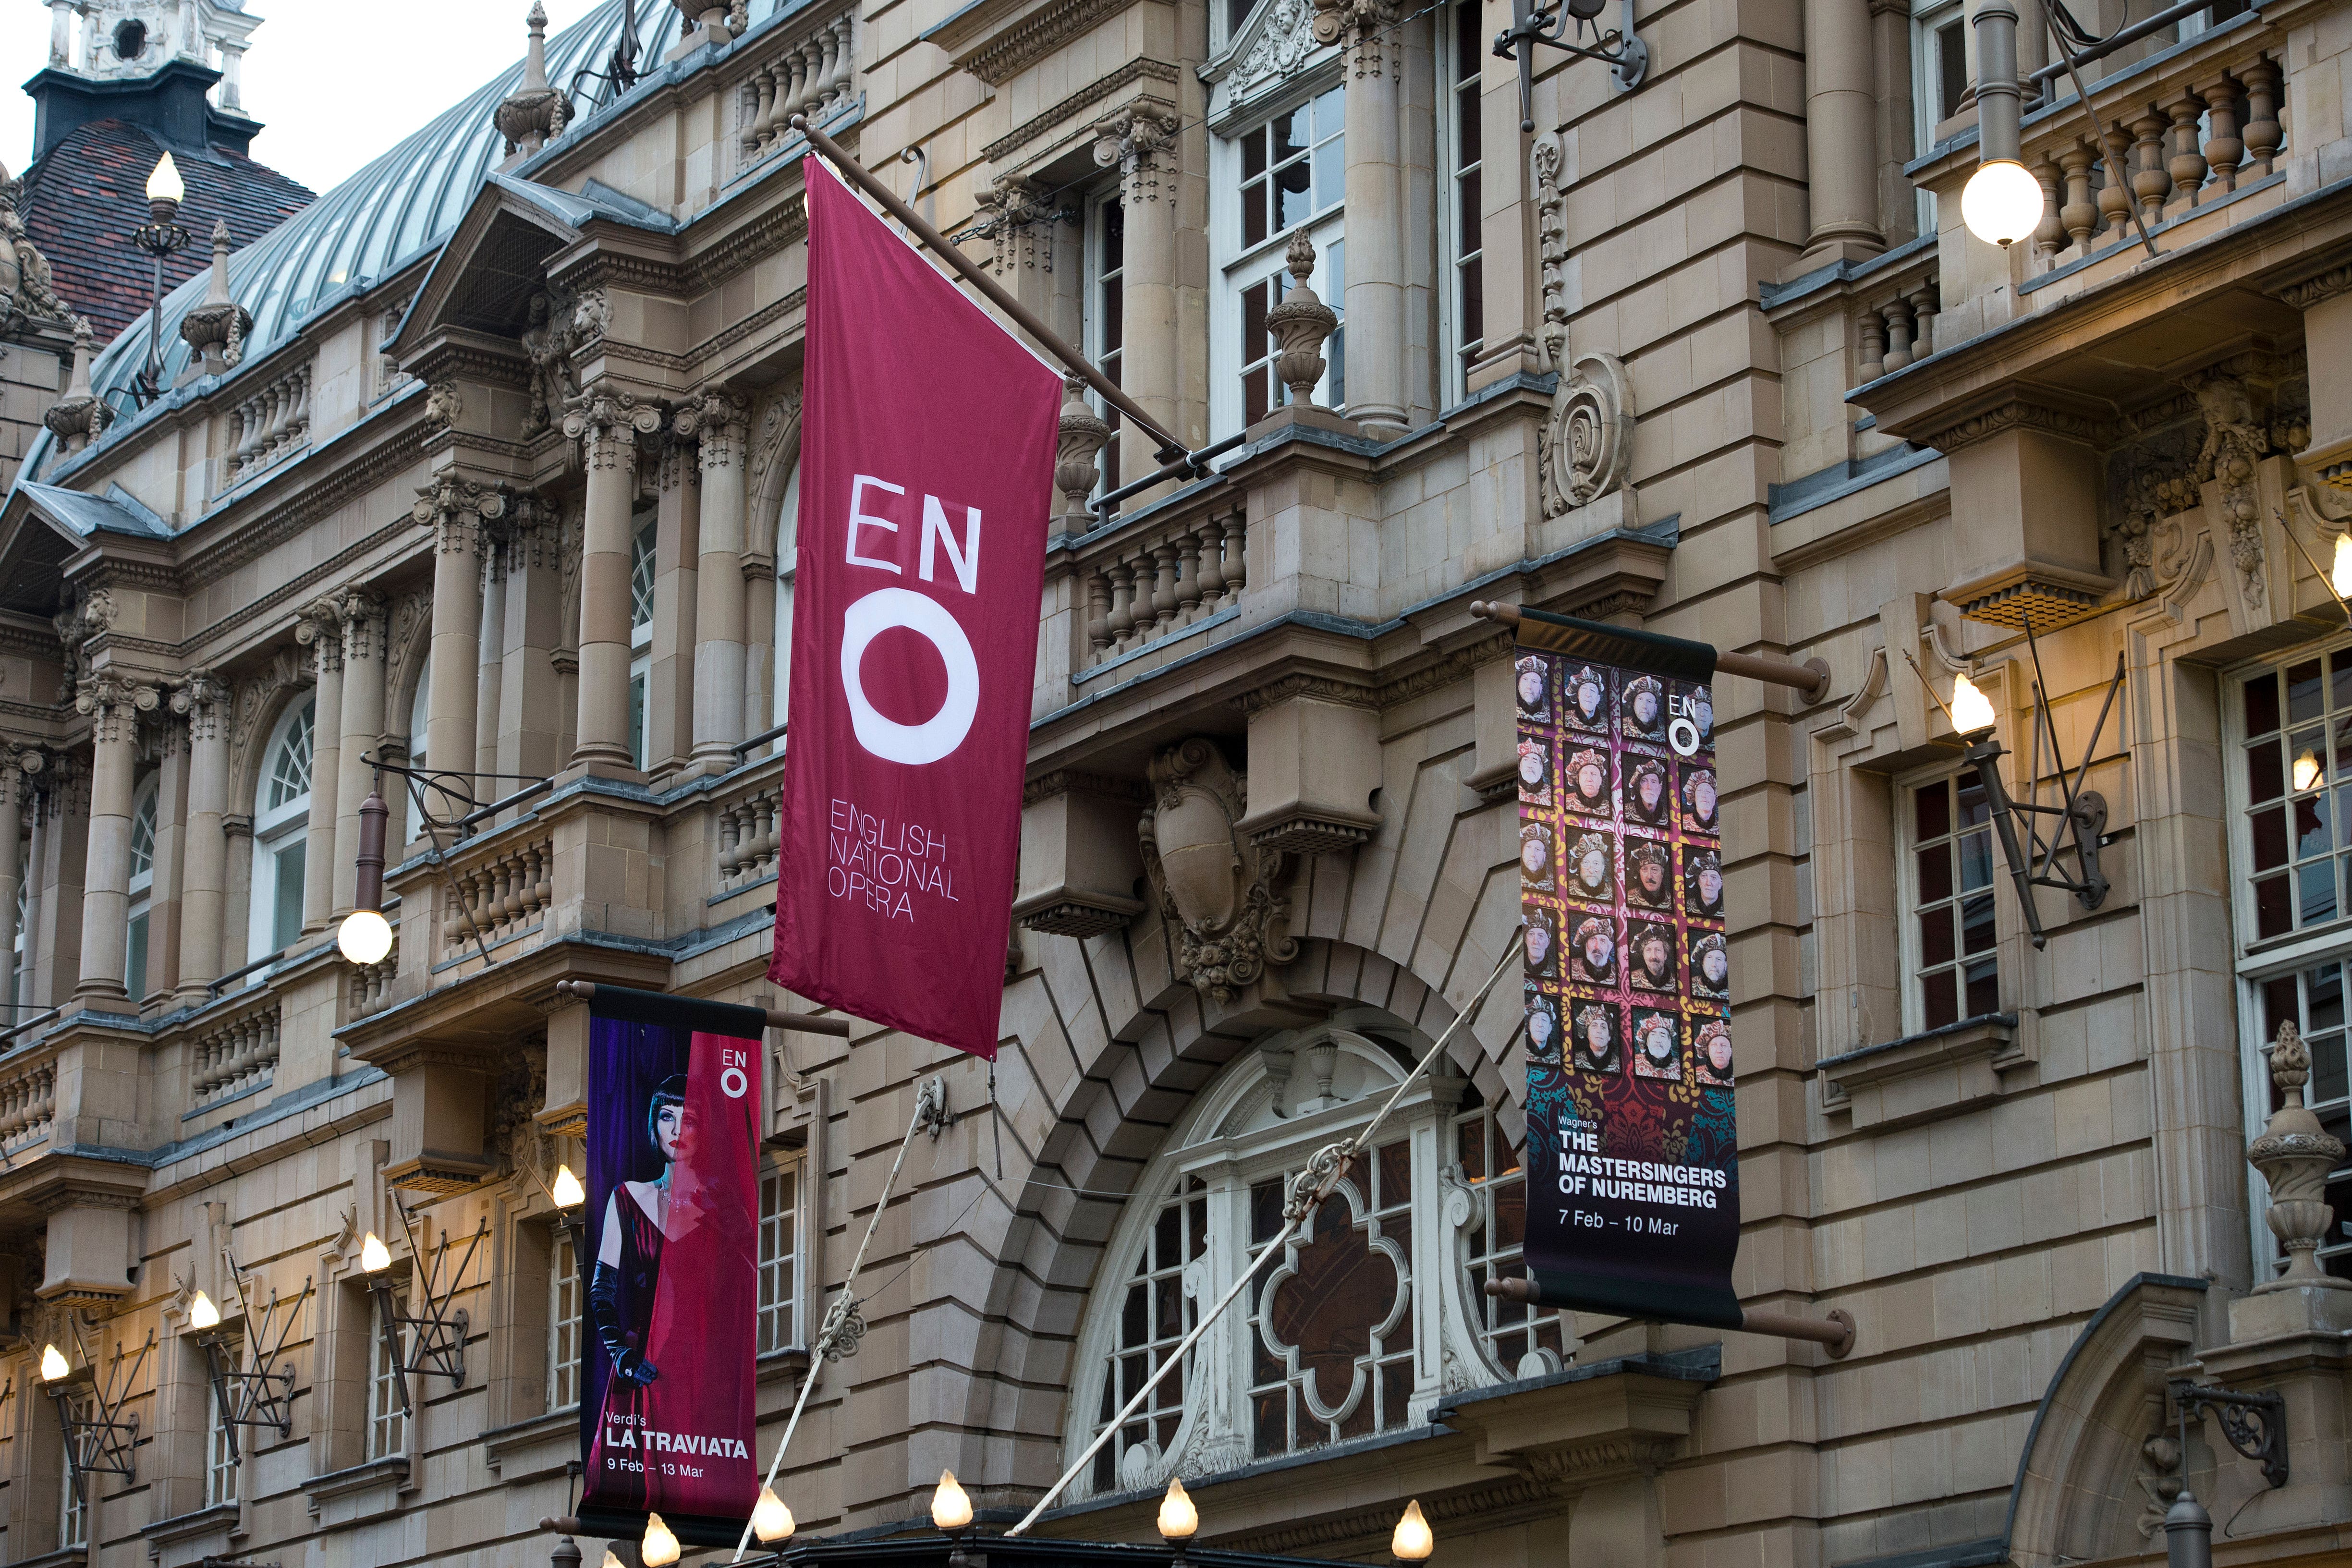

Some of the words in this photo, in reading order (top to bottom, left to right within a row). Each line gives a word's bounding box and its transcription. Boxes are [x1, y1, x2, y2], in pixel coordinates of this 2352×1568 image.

[846, 474, 981, 594] EN
[841, 587, 979, 765] O
[1669, 694, 1696, 719] EN
[1668, 718, 1700, 756] O
[831, 798, 945, 862] ENGLISH
[830, 831, 959, 901] NATIONAL
[829, 866, 914, 923] OPERA
[722, 1049, 746, 1068] EN
[720, 1067, 748, 1098] O
[1558, 1115, 1597, 1129] Wagner's
[1559, 1130, 1598, 1153] THE
[1559, 1152, 1727, 1188] MASTERSINGERS
[1559, 1174, 1586, 1194] OF
[1592, 1178, 1717, 1209] NUREMBERG
[1559, 1209, 1568, 1224] 7
[1574, 1210, 1603, 1228] Feb
[1625, 1216, 1643, 1232] 10
[1648, 1217, 1679, 1235] Mar
[606, 1410, 646, 1427] Verdi's
[606, 1427, 637, 1448] LA
[641, 1430, 749, 1459] TRAVIATA
[607, 1458, 615, 1470] 9
[620, 1459, 644, 1472] Feb
[661, 1463, 675, 1475] 13
[680, 1464, 704, 1478] Mar
